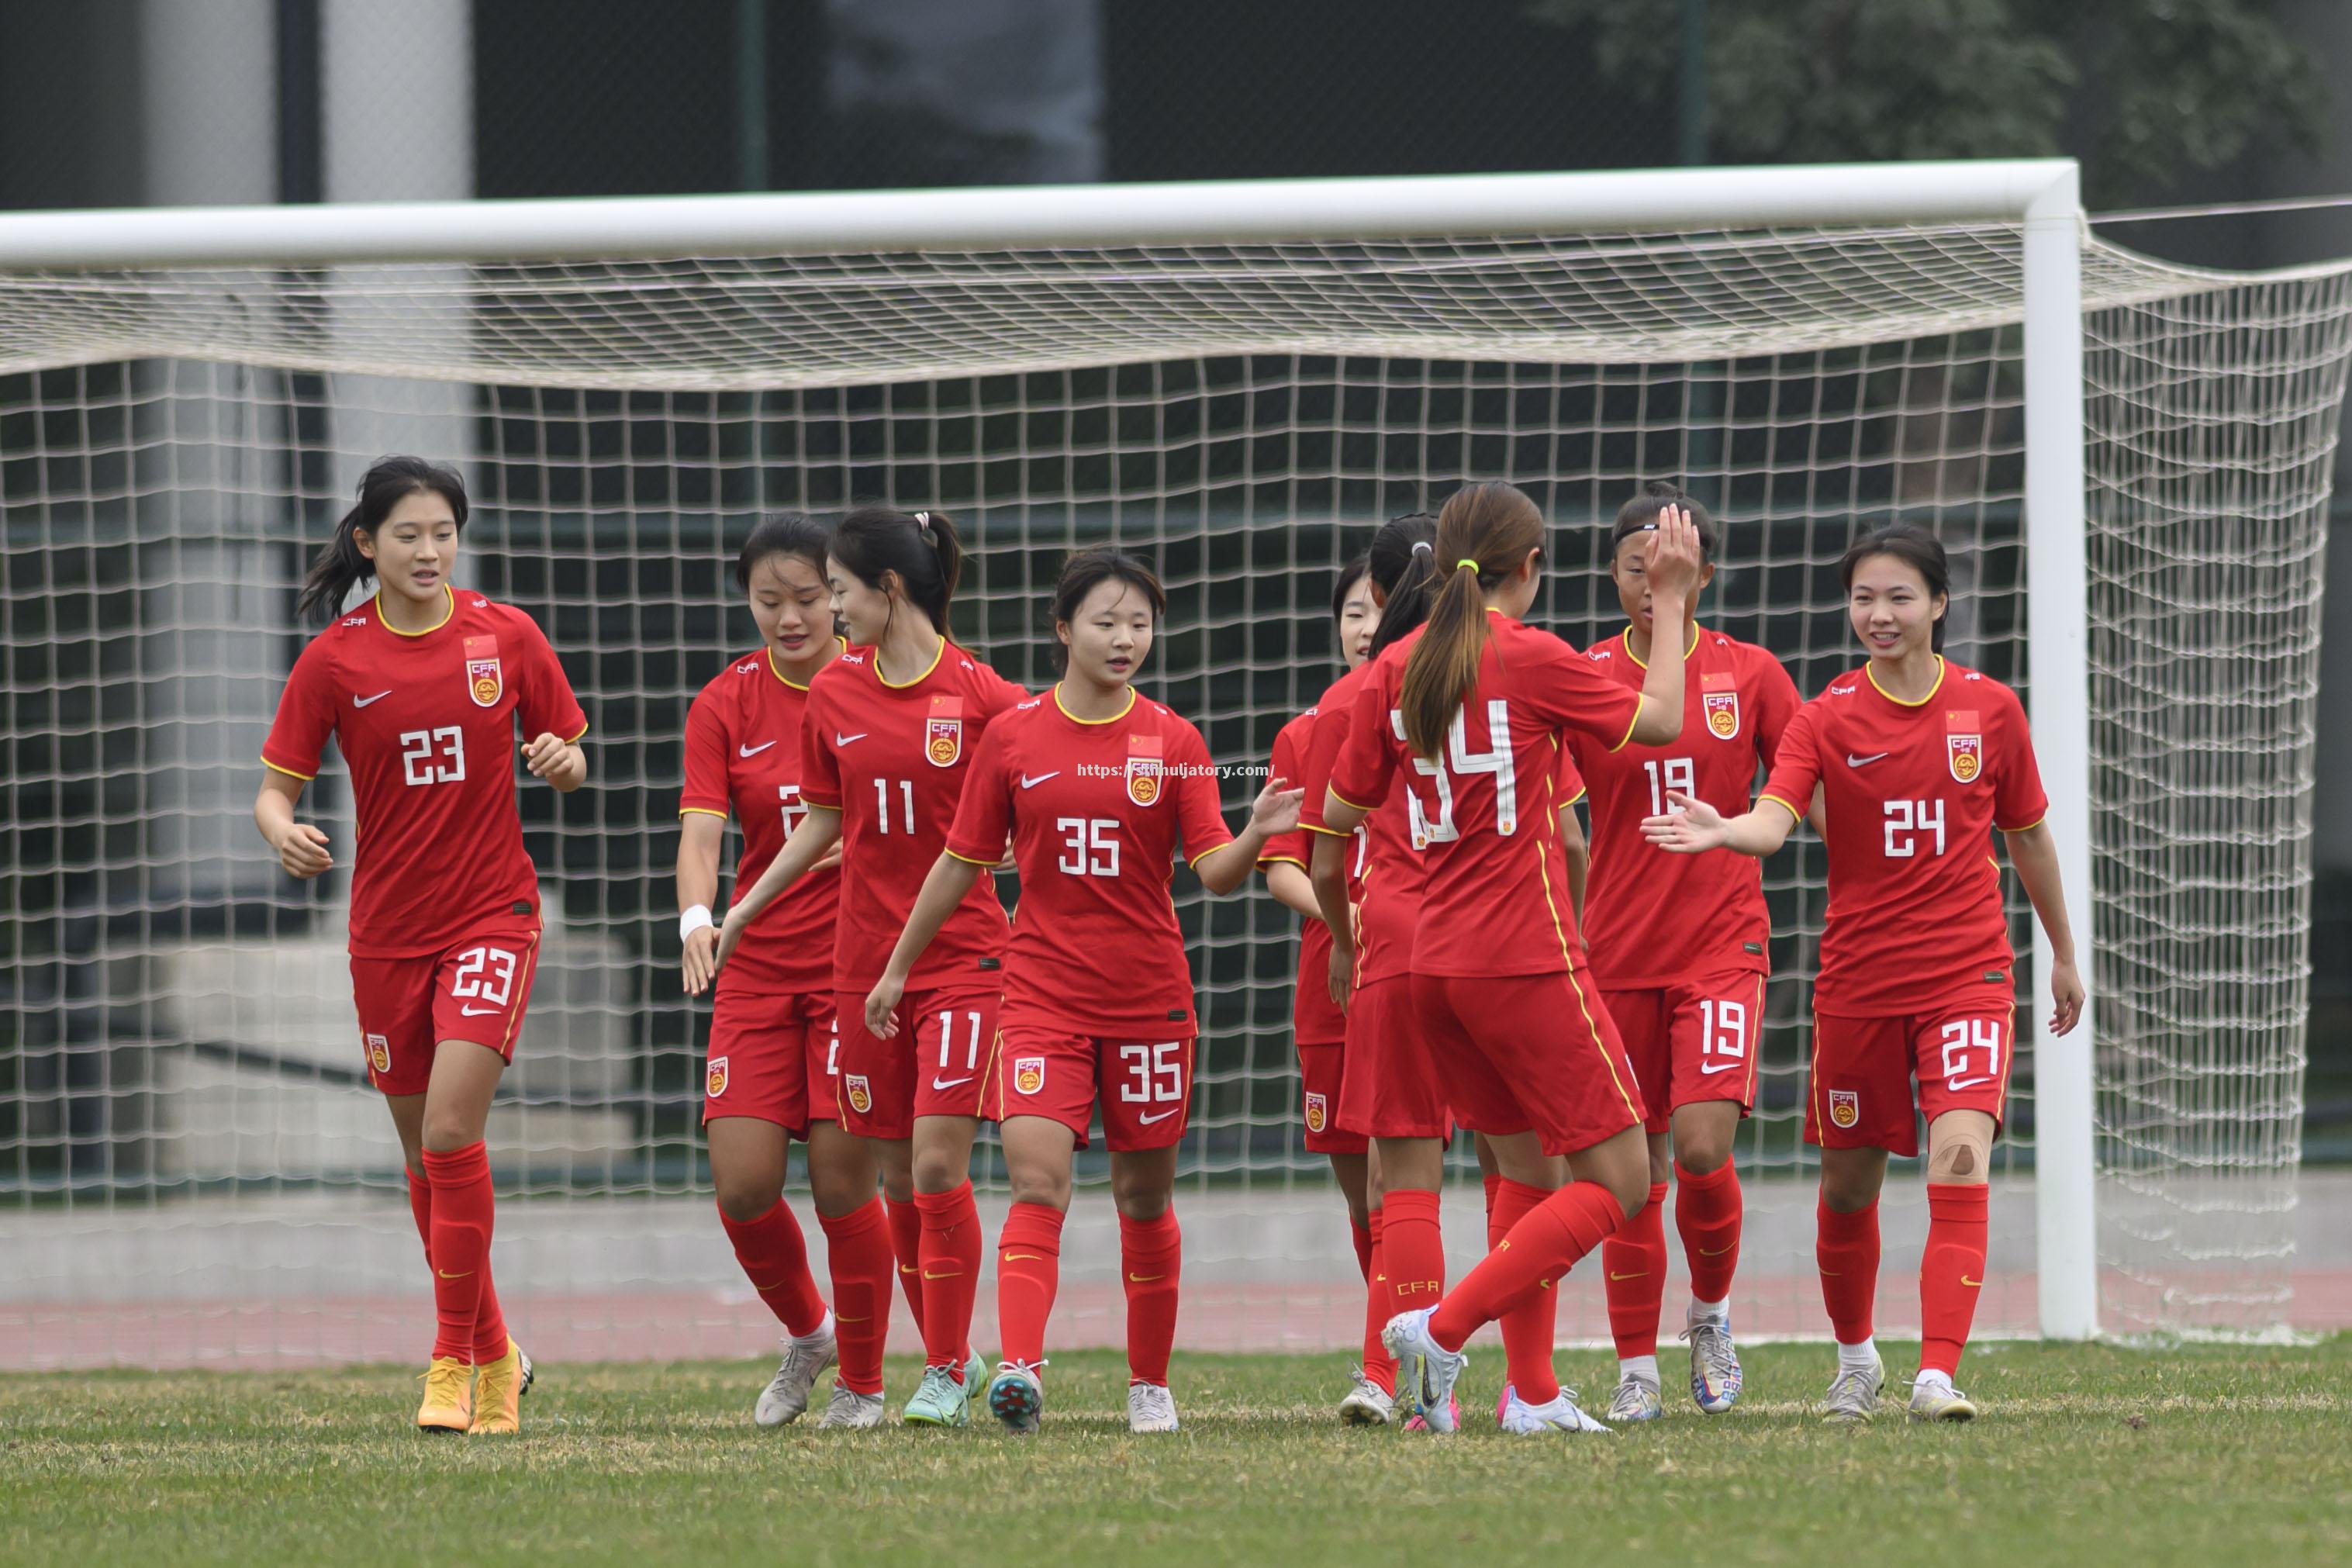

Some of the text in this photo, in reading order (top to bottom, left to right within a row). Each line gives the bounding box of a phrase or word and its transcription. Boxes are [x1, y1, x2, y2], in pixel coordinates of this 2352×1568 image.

[471, 663, 496, 673] CFA
[931, 724, 958, 733] CFA
[1708, 696, 1732, 706] CFA
[400, 726, 465, 786] 23
[1953, 739, 1977, 748] CFA
[874, 779, 915, 834] 11
[1643, 757, 1695, 816] 19
[1057, 817, 1120, 876] 35
[1884, 799, 1945, 857] 24
[451, 947, 516, 1007] 23
[939, 1011, 981, 1069] 11
[1700, 1000, 1746, 1058] 19
[1941, 1019, 1999, 1078] 24
[1120, 1041, 1182, 1102] 35
[1397, 1280, 1438, 1297] CFA
